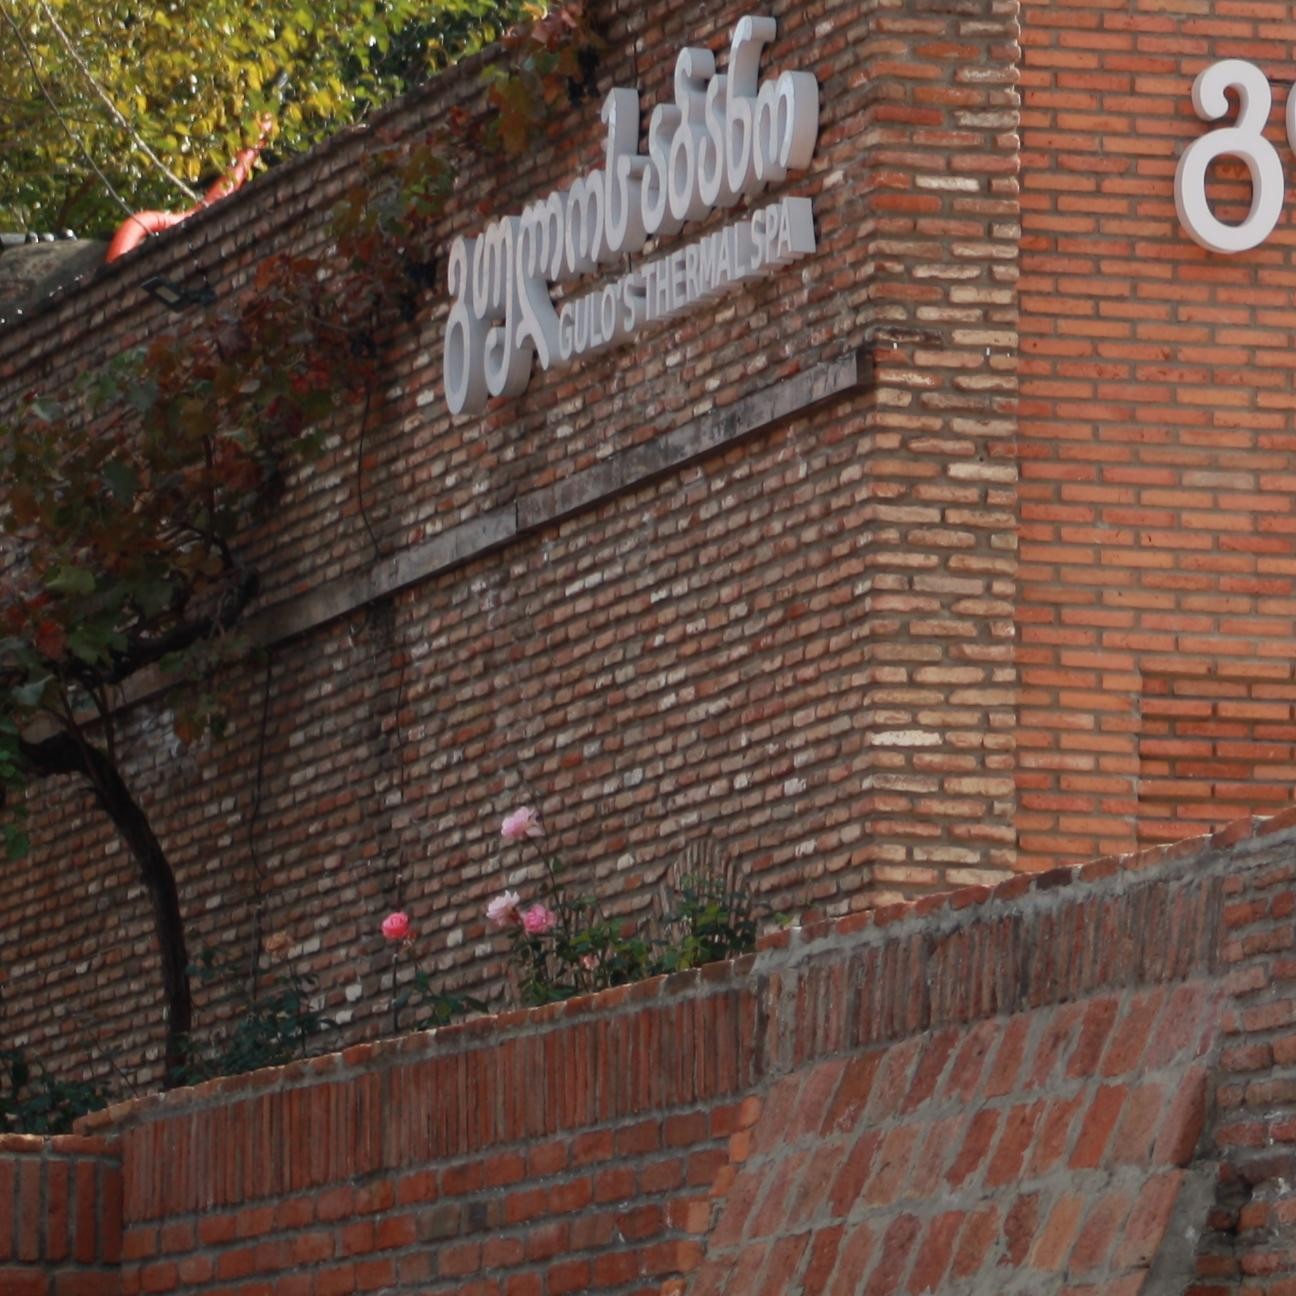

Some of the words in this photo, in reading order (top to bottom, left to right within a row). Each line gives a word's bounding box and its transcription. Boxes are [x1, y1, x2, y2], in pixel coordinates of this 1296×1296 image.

[443, 87, 646, 416] გულოს
[641, 15, 820, 236] აბანო
[558, 273, 643, 361] GULO'S
[641, 221, 753, 322] THERMAL
[750, 196, 816, 271] SPA
